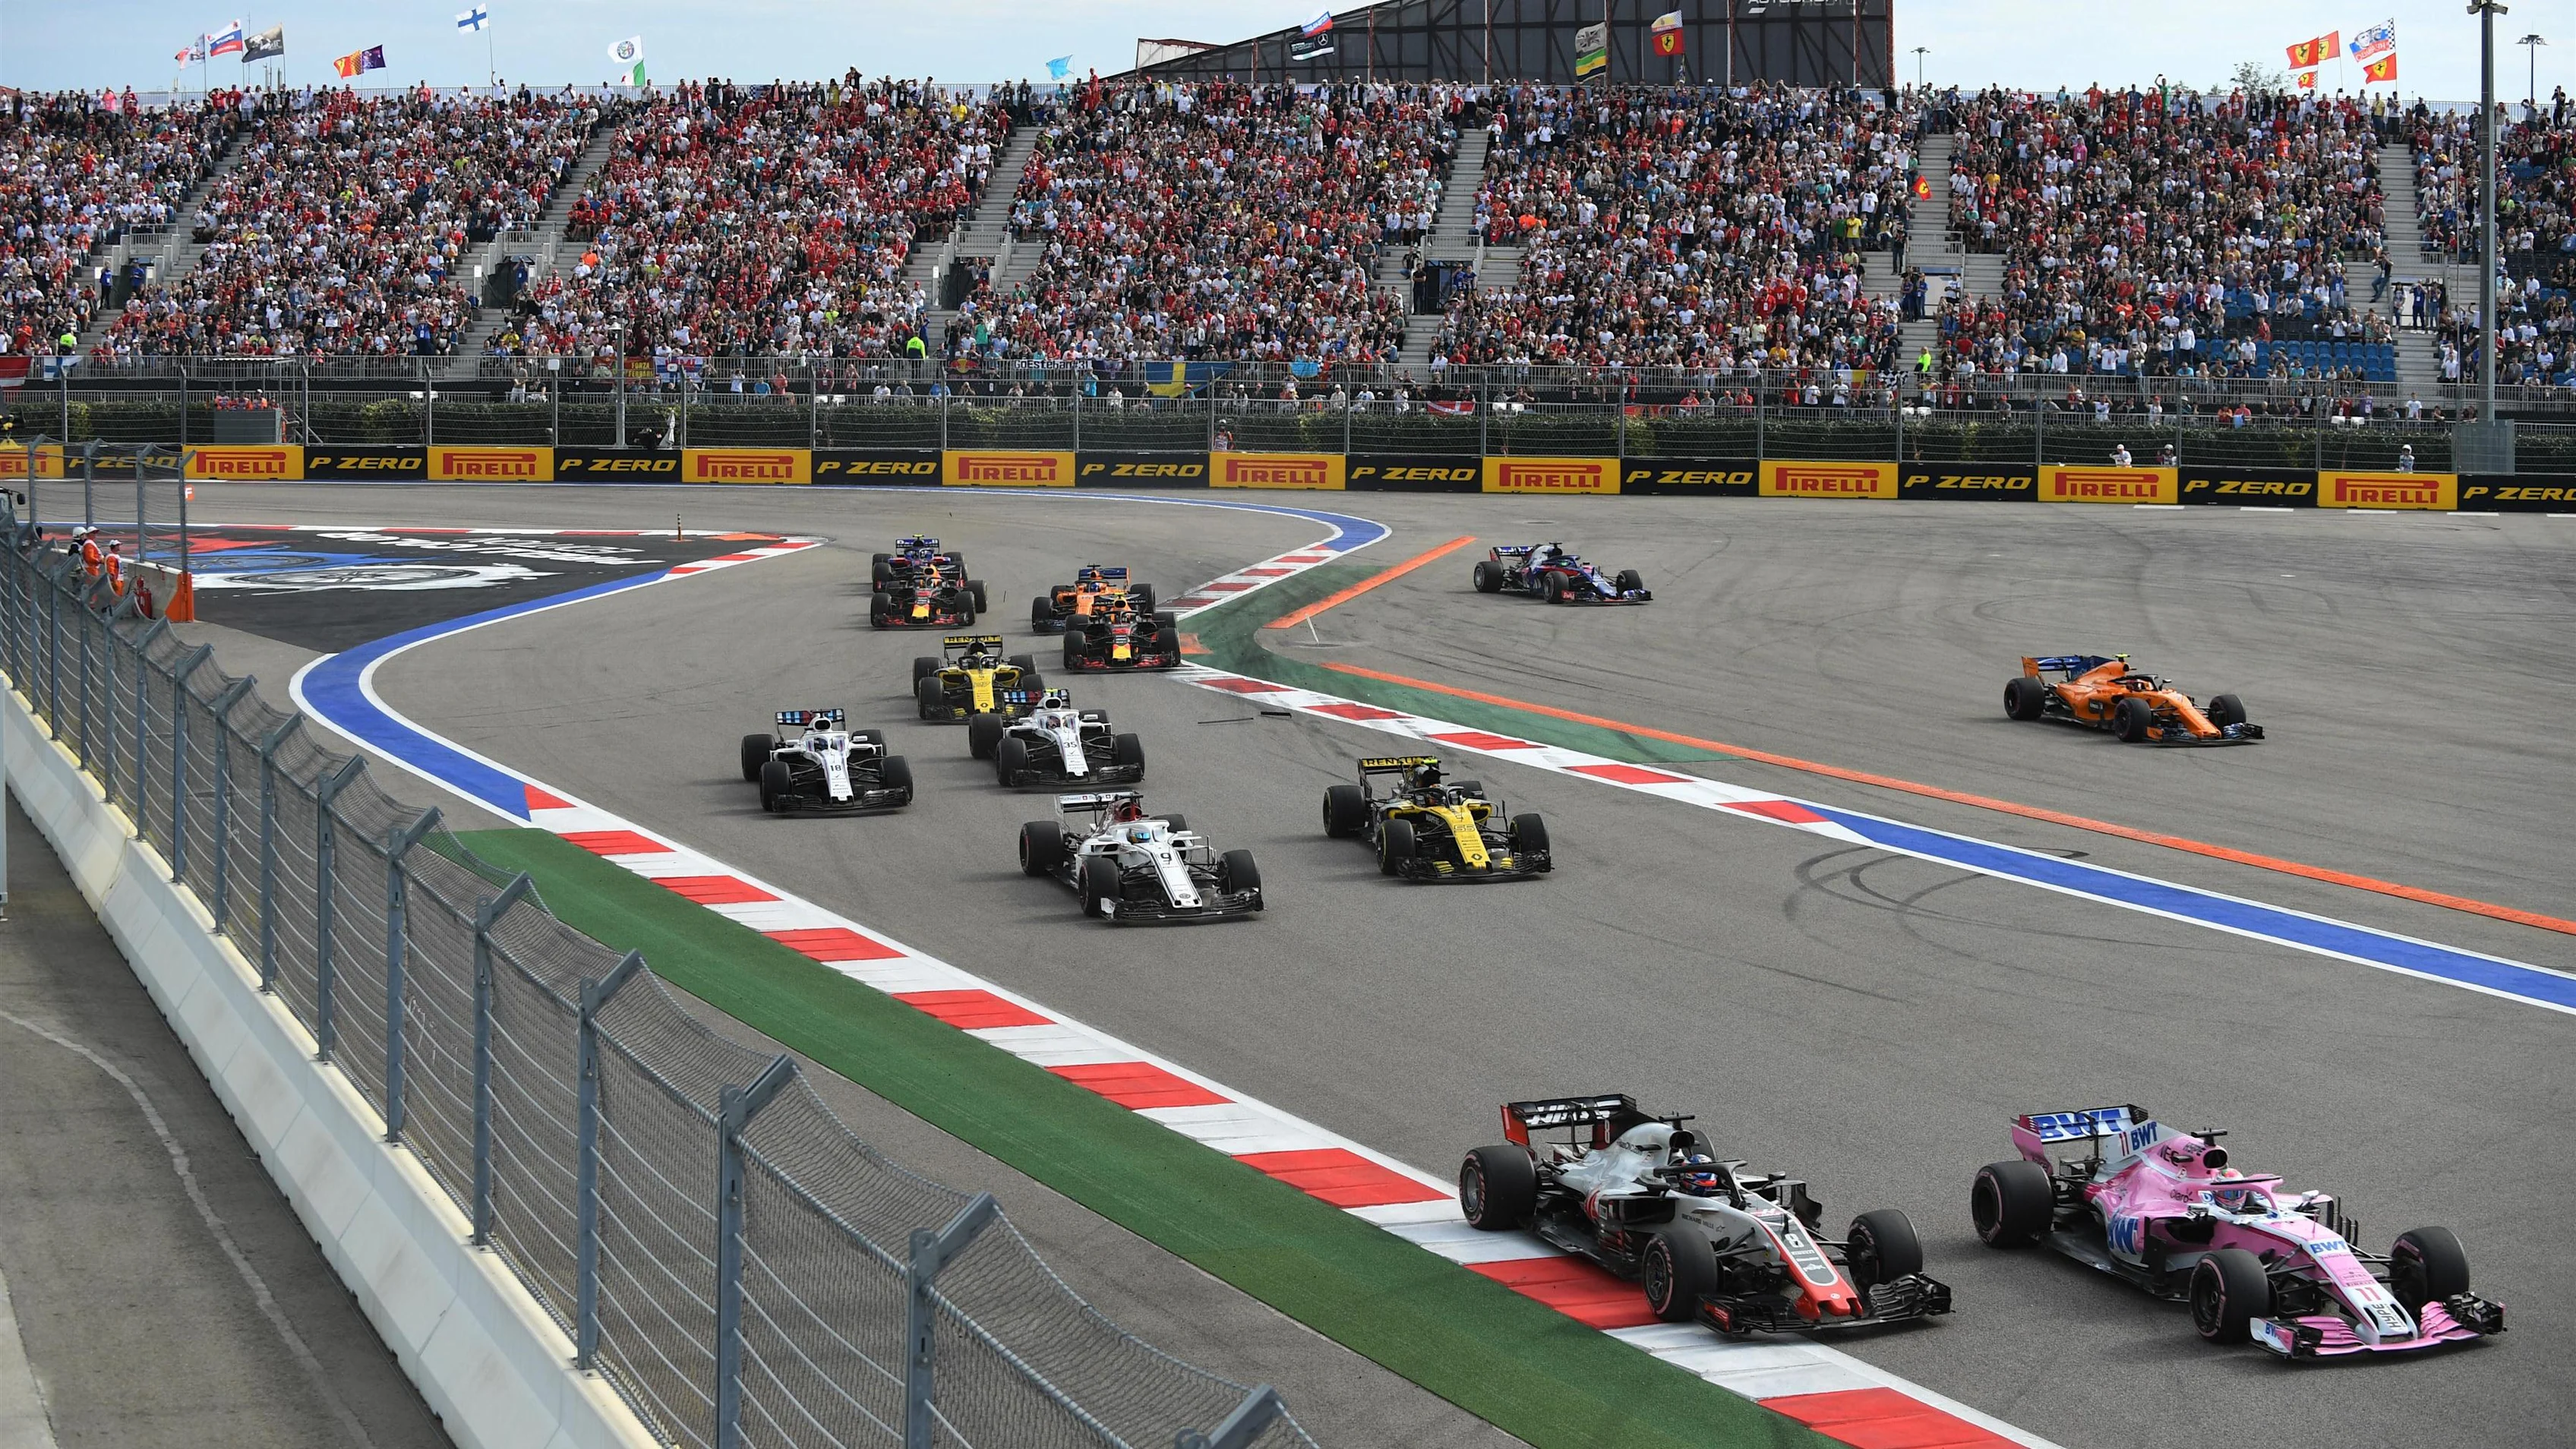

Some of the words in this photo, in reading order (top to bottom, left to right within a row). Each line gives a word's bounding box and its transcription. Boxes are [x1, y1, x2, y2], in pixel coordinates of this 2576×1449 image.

[195, 452, 286, 474] PIRELLI
[311, 457, 332, 469] P
[337, 457, 422, 469] ZERO
[444, 453, 536, 475] PIRELLI
[560, 459, 583, 471] P
[589, 459, 676, 471] ZERO
[698, 456, 794, 478] PIRELLI
[817, 462, 841, 473] P
[847, 462, 936, 475] ZERO
[959, 457, 1057, 481] PIRELLI
[1081, 464, 1106, 476] P
[1113, 464, 1204, 477] ZERO
[1226, 460, 1327, 484] PIRELLI
[1352, 467, 1376, 479] P
[1382, 468, 1476, 481] ZERO
[1500, 464, 1602, 488] PIRELLI
[1627, 471, 1652, 483] P
[1658, 471, 1753, 485] ZERO
[1776, 467, 1879, 492] PIRELLI
[1905, 475, 1930, 488] P
[1936, 475, 2032, 490] ZERO
[2056, 473, 2159, 497] PIRELLI
[2185, 480, 2209, 493] P
[2215, 481, 2312, 495] ZERO
[2336, 478, 2439, 504] PIRELLI
[2464, 486, 2489, 499] P
[316, 532, 478, 549] COLOR
[453, 547, 665, 565] PIRELLI
[1454, 824, 1476, 833] 55
[1160, 852, 1173, 863] 9
[2031, 1109, 2123, 1139] BWT
[2119, 1131, 2130, 1157] 11
[2131, 1120, 2158, 1151] BWT
[1785, 1233, 1804, 1249] 8
[2309, 1239, 2347, 1255] BWT
[2355, 1286, 2382, 1302] 11
[2371, 1303, 2401, 1329] HYPE
